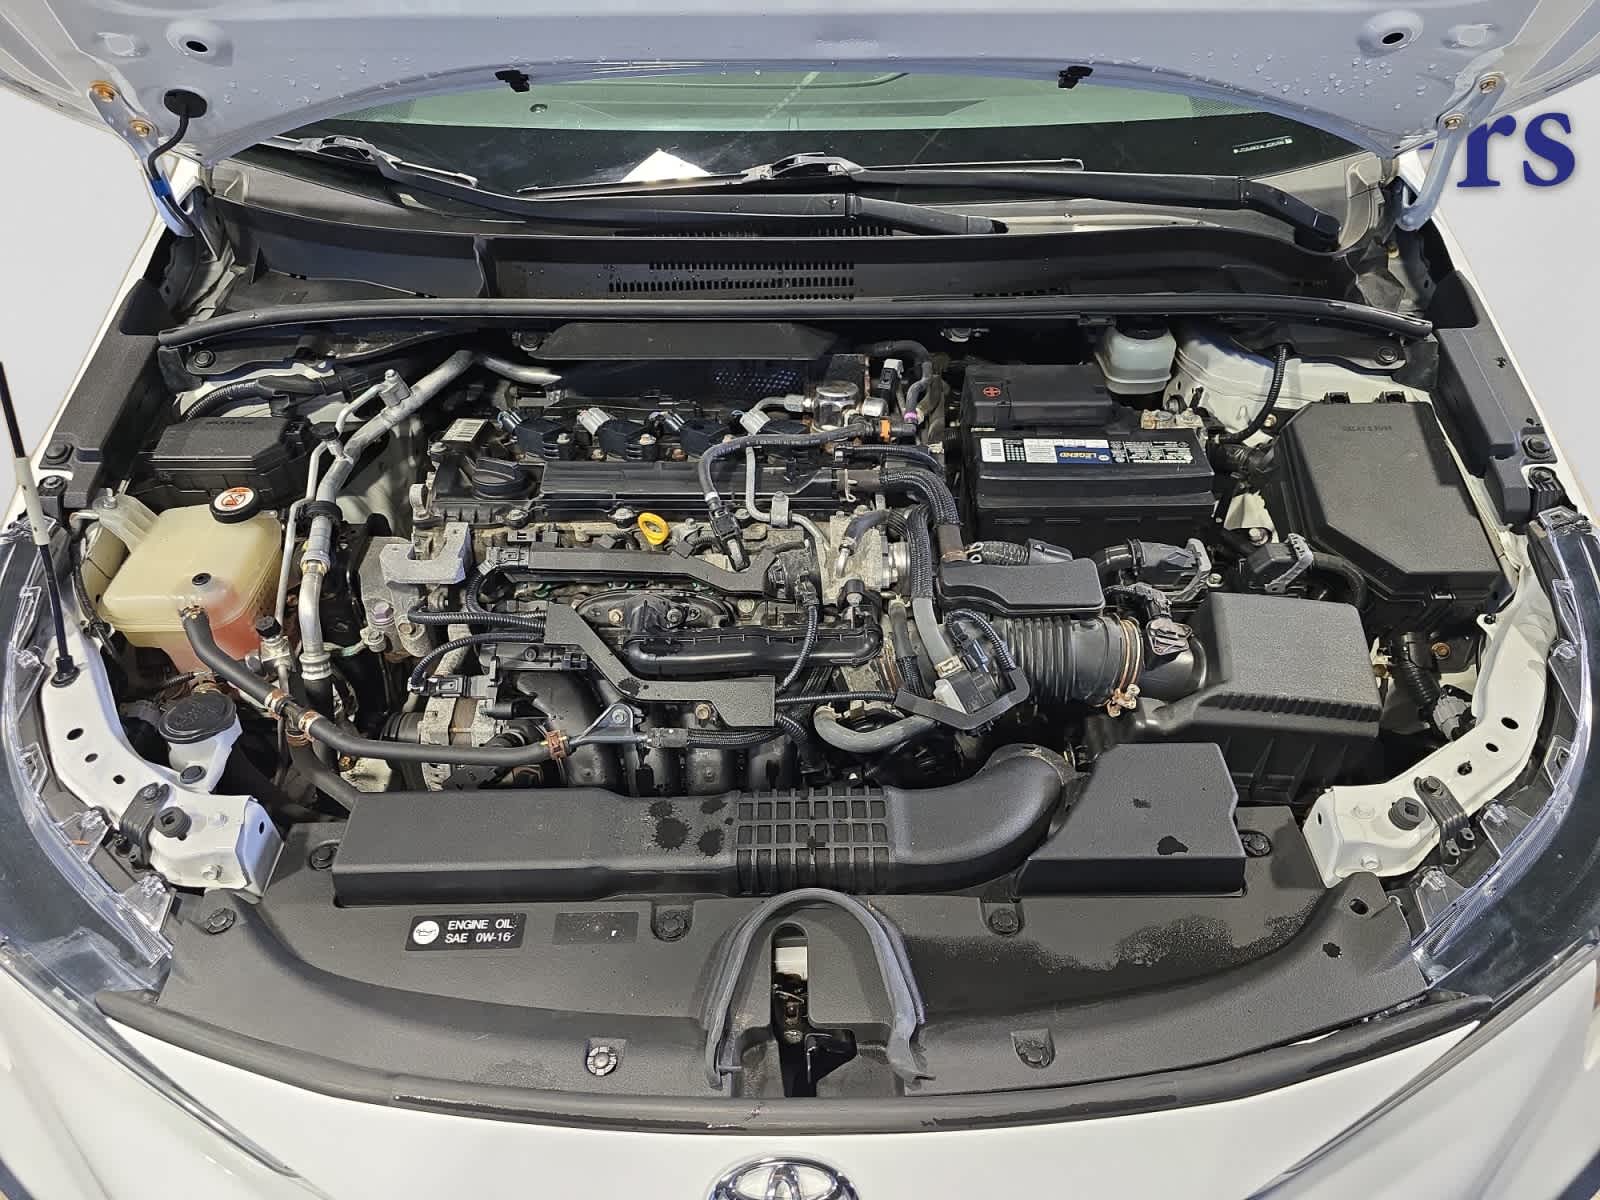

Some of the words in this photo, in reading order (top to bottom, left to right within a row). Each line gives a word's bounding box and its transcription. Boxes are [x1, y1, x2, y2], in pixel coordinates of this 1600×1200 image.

[1420, 112, 1576, 188] rs
[447, 919, 489, 930] ENGINE
[495, 919, 513, 929] OIL
[444, 933, 468, 944] SAE
[475, 932, 511, 943] 0W-16
